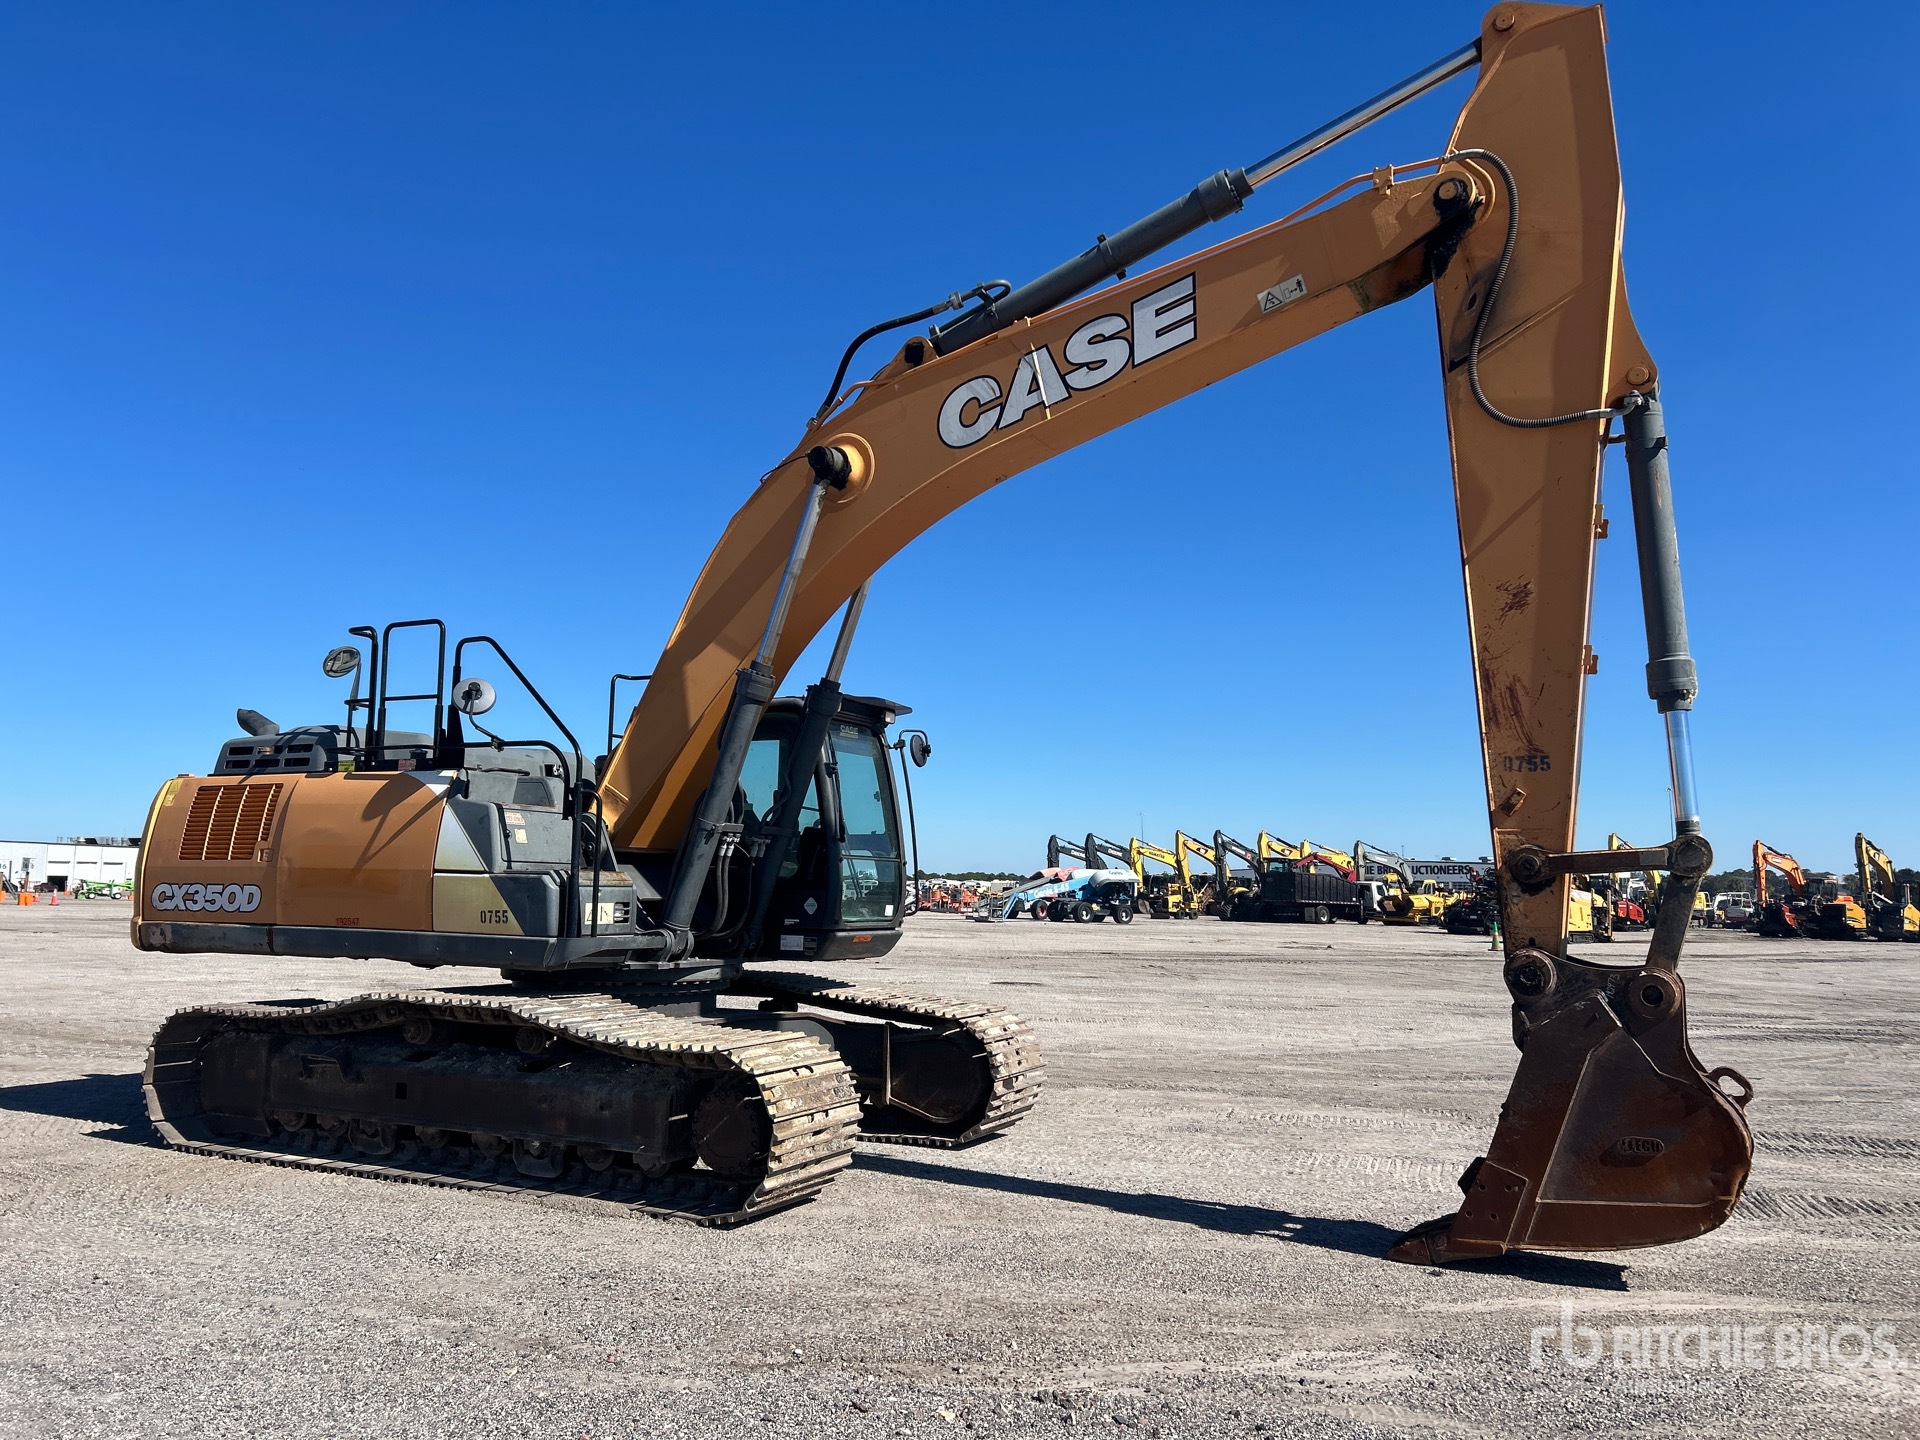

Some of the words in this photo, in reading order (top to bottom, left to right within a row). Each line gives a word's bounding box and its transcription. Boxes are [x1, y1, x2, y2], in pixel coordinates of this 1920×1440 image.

[937, 272, 1197, 449] CASE
[840, 724, 859, 735] CASE
[1503, 754, 1551, 772] 0755
[1411, 865, 1470, 875] UCTIONEERS
[151, 882, 262, 913] CX350D
[480, 910, 508, 924] 0755
